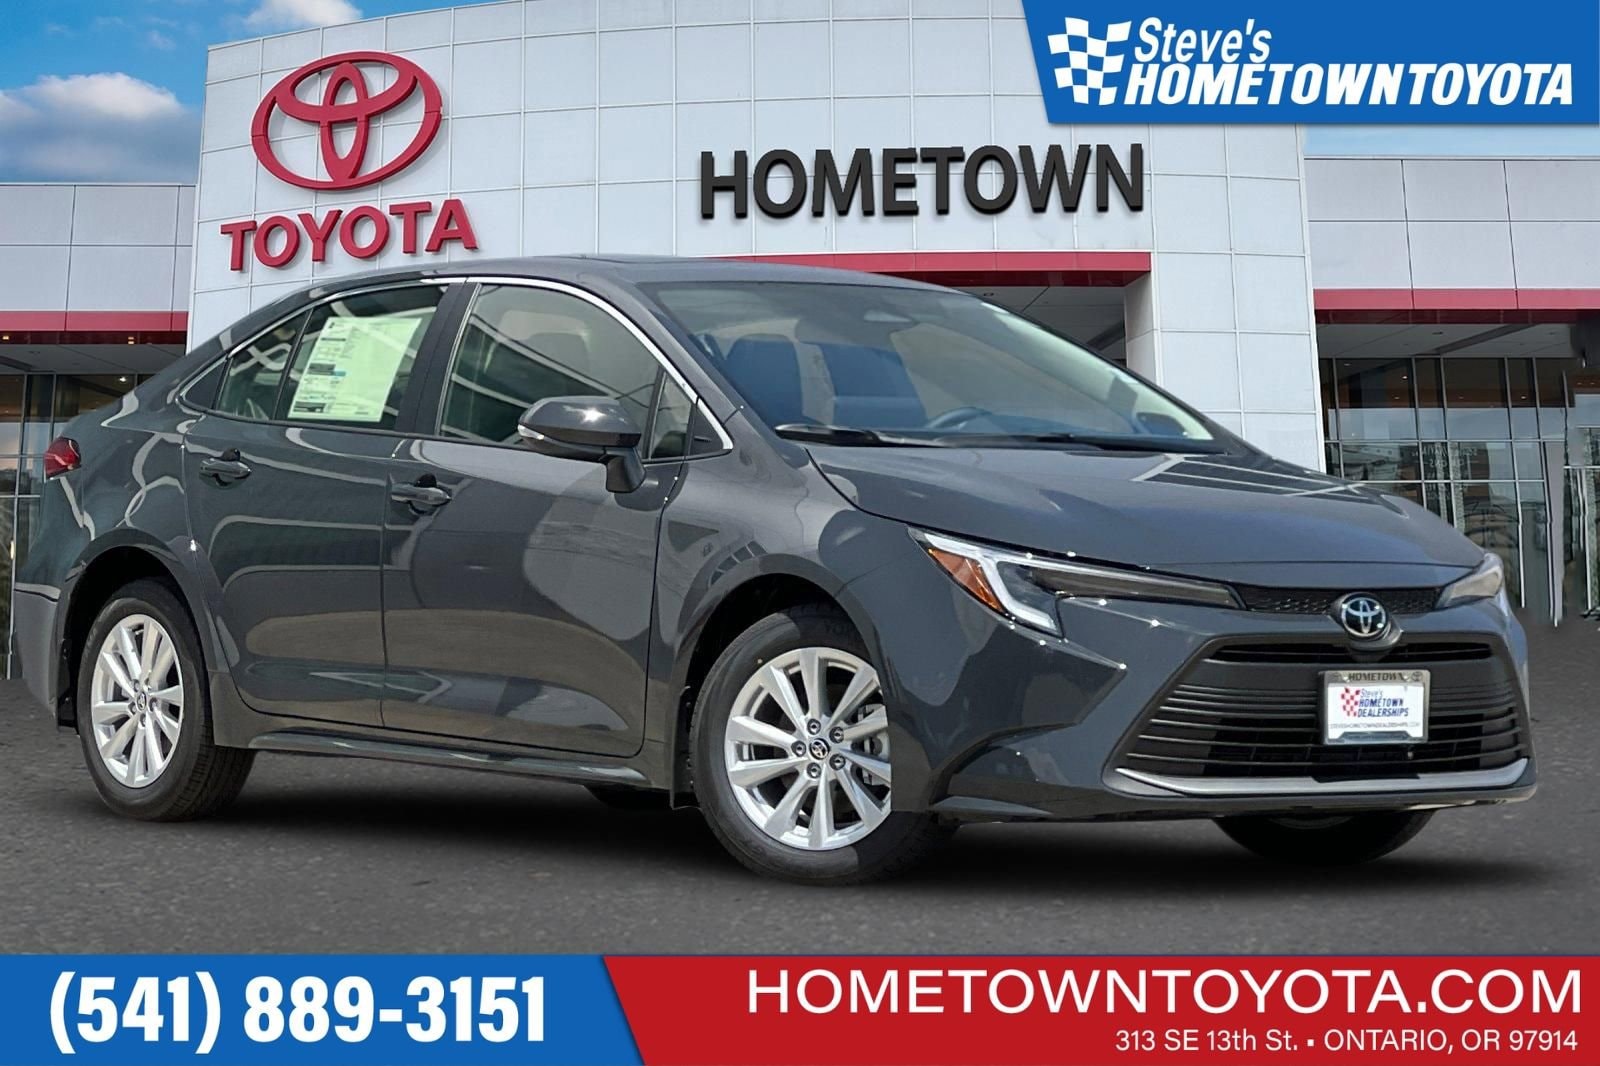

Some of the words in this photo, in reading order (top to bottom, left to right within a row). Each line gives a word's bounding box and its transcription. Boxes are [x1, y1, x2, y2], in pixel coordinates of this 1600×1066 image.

[700, 143, 1146, 220] HOMETOWN
[220, 198, 478, 272] TOYOTA
[1348, 672, 1405, 681] HOMETOWN
[1359, 698, 1403, 707] HOMETOWN
[1358, 707, 1409, 717] DEALERSHIPS
